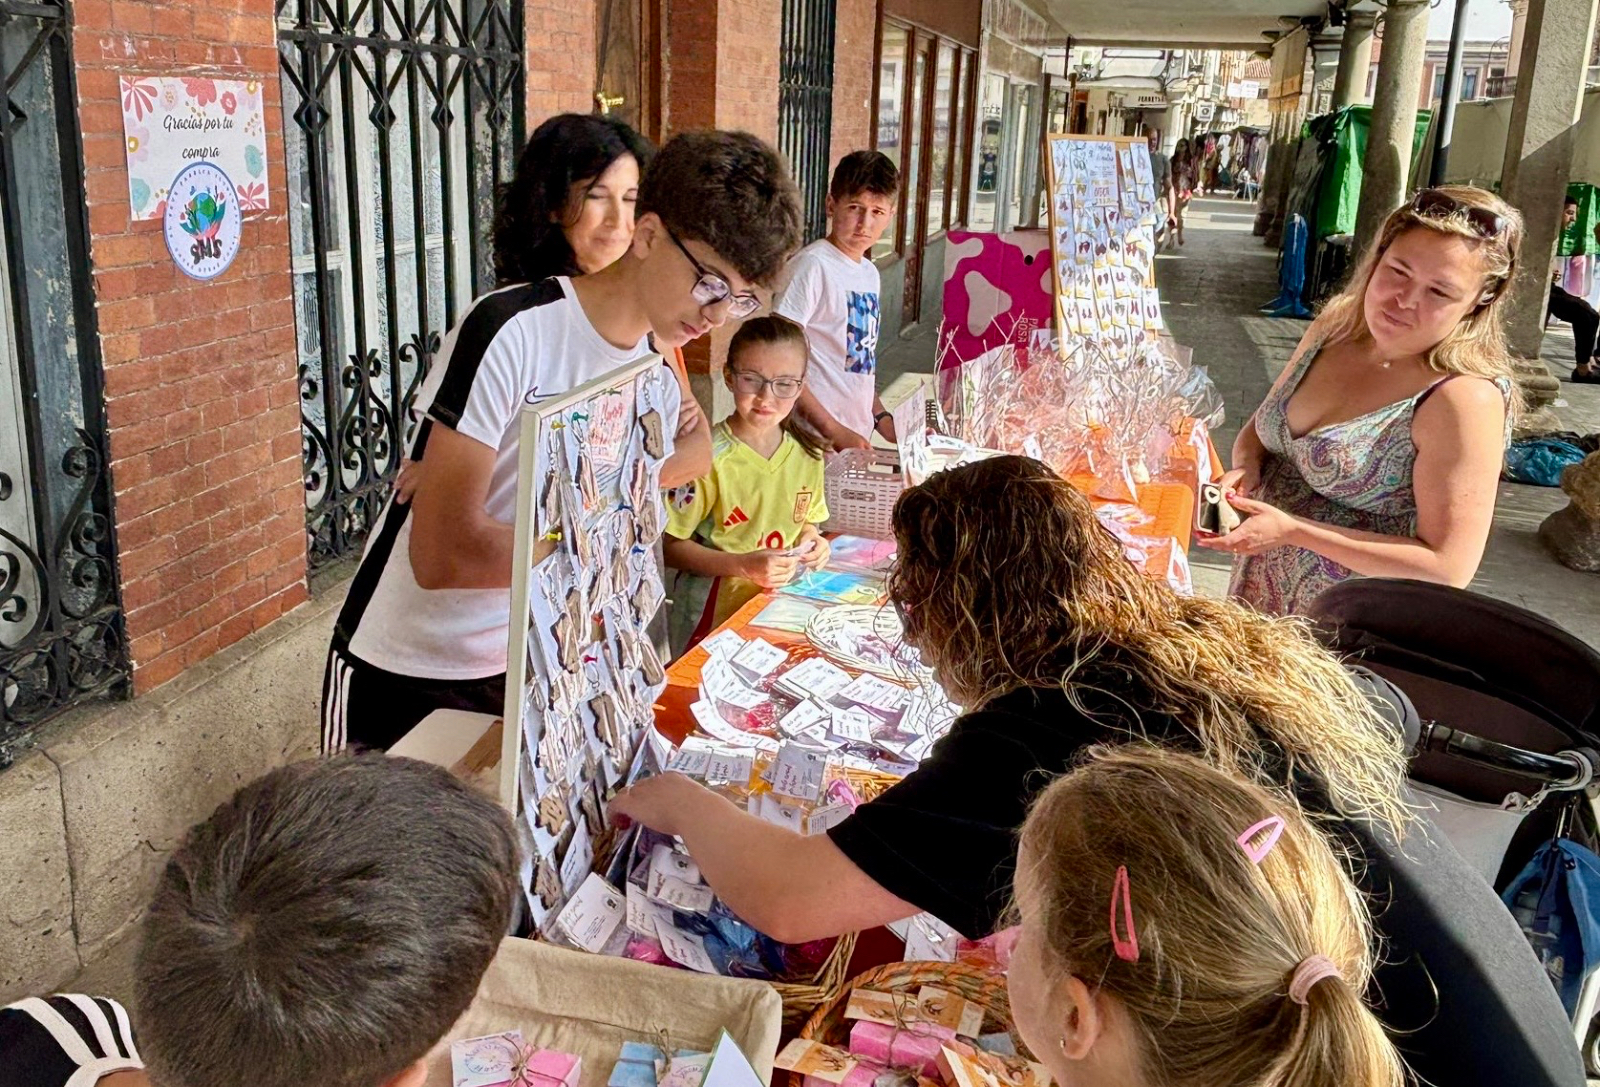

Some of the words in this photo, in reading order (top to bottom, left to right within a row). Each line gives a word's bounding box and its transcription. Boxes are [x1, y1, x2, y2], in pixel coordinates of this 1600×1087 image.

[163, 114, 202, 133] Gracias
[202, 118, 221, 133] por
[222, 116, 234, 129] tu
[182, 146, 220, 161] compra
[1018, 317, 1028, 342] ROSA
